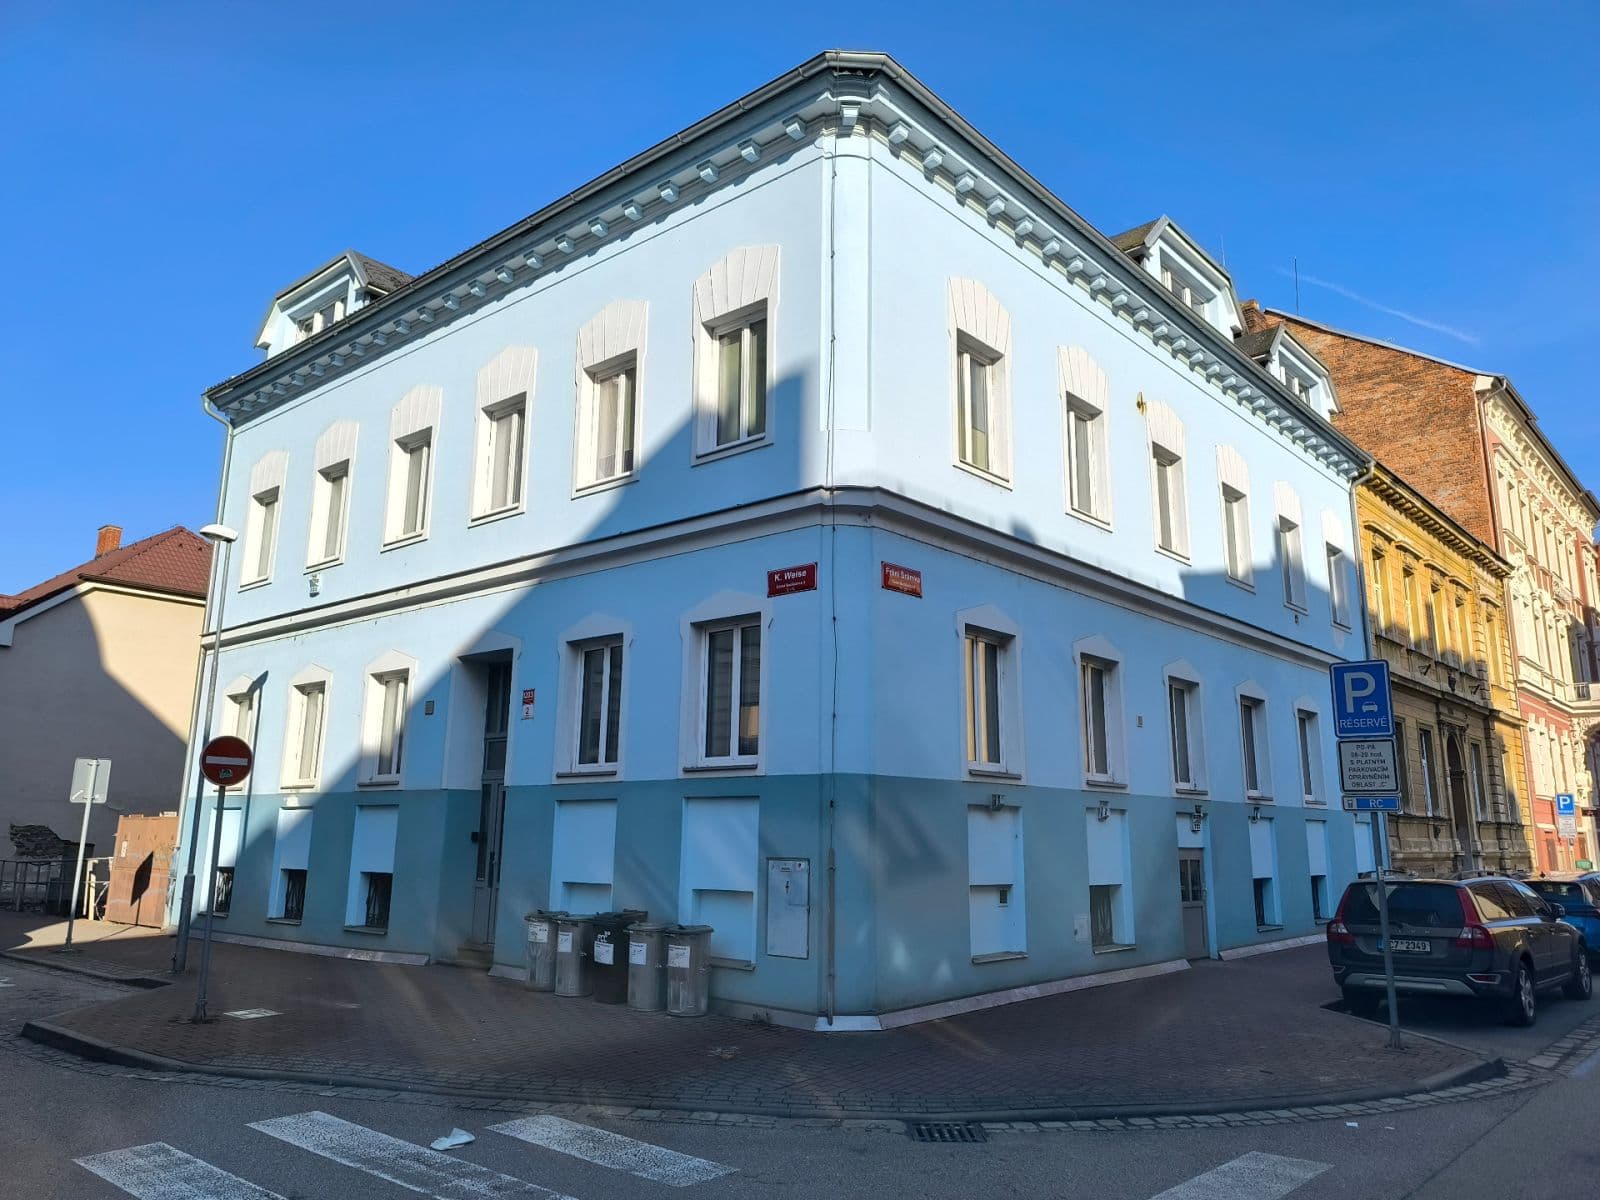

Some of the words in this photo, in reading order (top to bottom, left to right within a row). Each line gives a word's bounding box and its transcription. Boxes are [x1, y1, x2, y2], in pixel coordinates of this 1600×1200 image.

[774, 573, 783, 582] K.
[1344, 671, 1375, 713] P
[1369, 799, 1384, 808] RC
[1560, 796, 1570, 809] P
